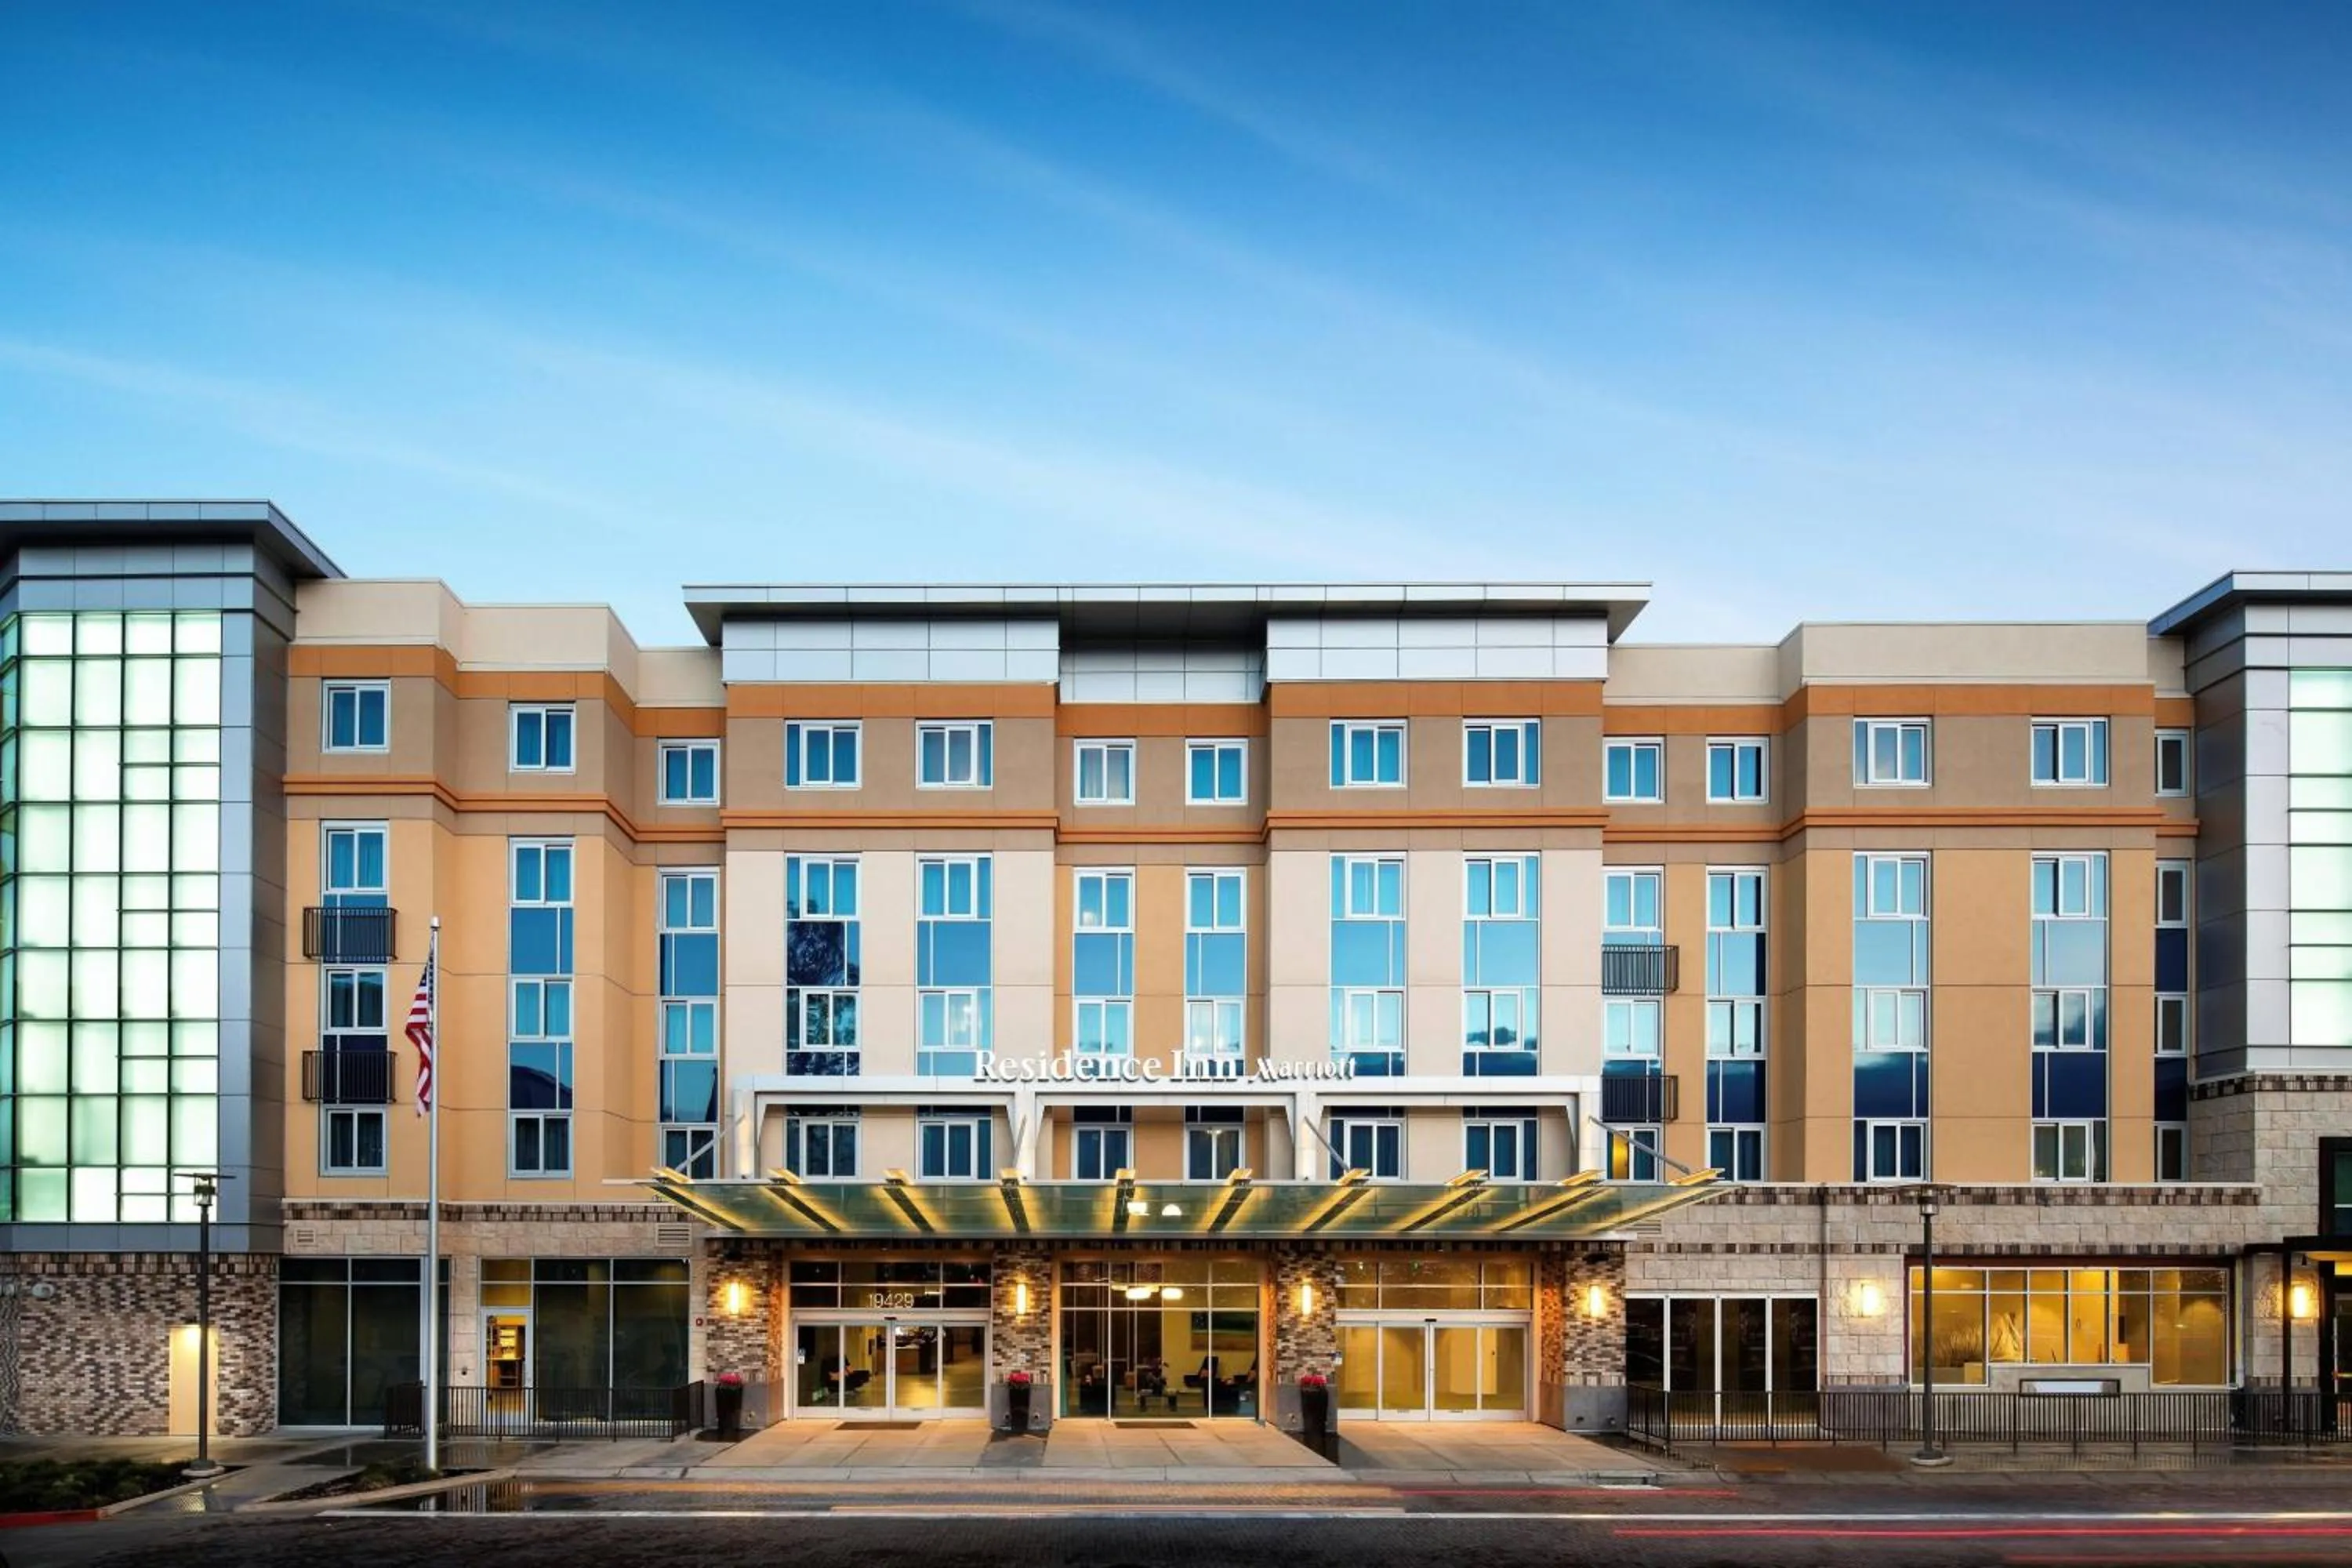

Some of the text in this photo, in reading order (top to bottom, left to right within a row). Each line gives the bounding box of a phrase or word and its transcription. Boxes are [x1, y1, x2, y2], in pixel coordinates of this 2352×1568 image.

[974, 1049, 1356, 1082] Residence Inn Marriott
[869, 1292, 914, 1308] 19429
